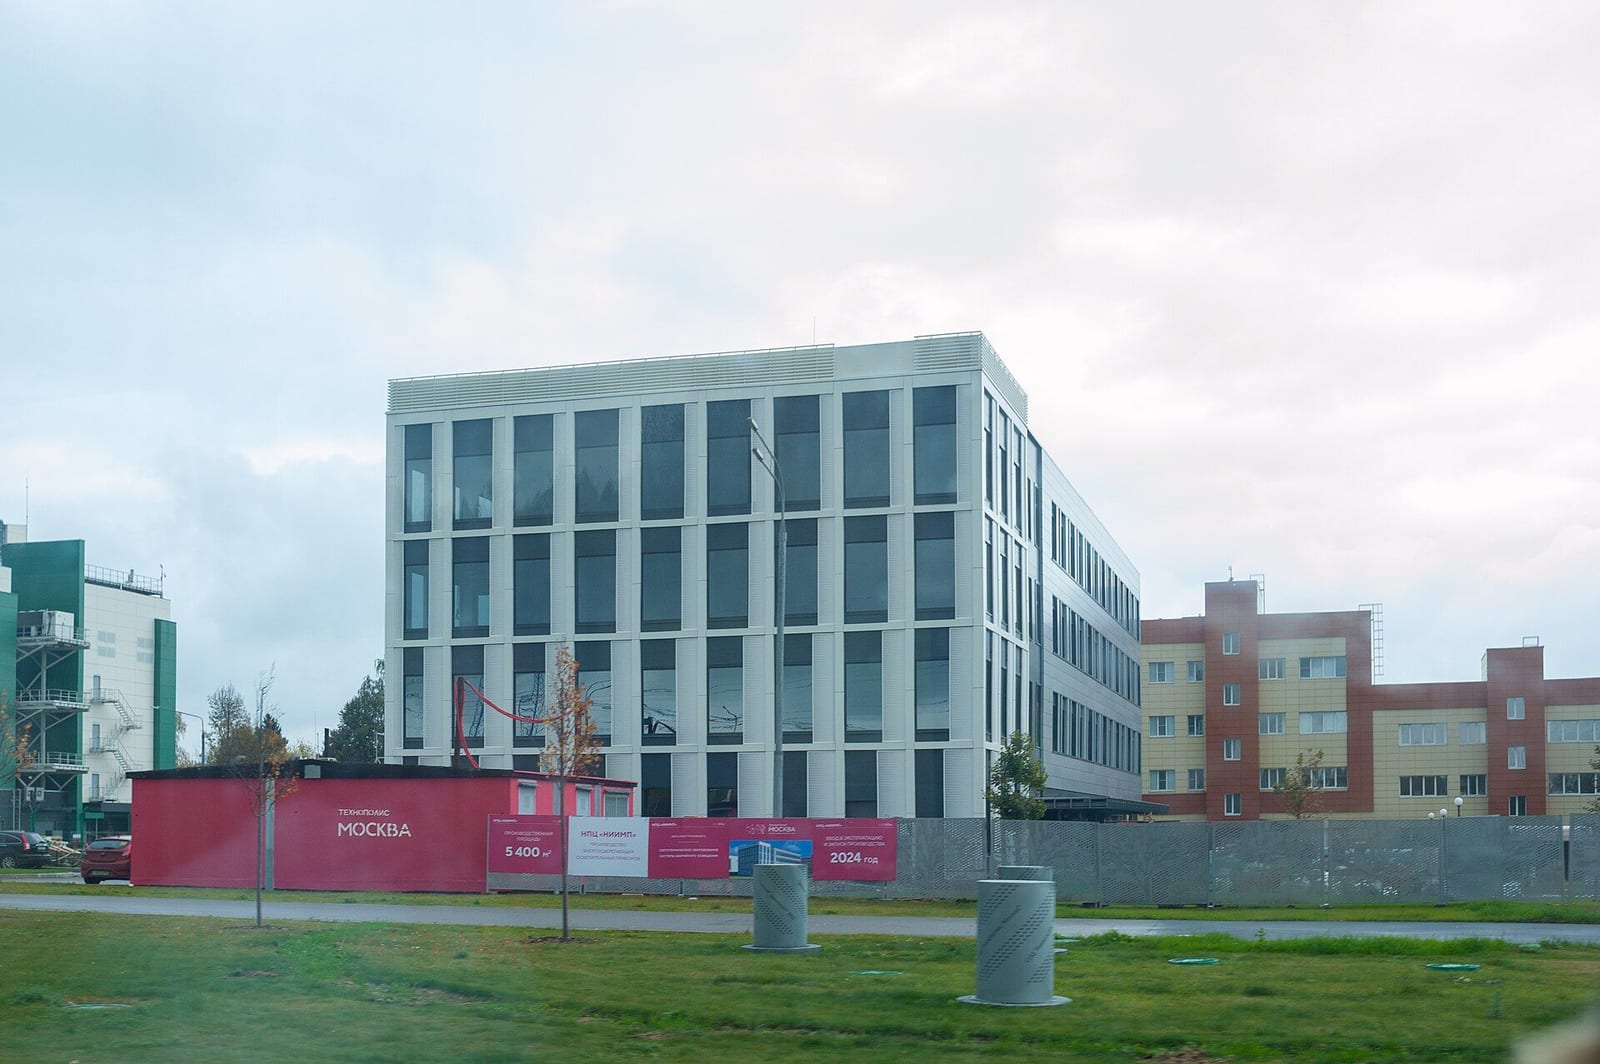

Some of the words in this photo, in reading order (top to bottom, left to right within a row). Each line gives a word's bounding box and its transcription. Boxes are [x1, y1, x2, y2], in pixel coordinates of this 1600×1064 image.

[338, 808, 390, 816] ТЕХНОПОЛИС
[337, 822, 412, 837] МОСКВА
[580, 830, 598, 838] НПЦ
[830, 852, 862, 864] 2024
[863, 856, 879, 864] год
